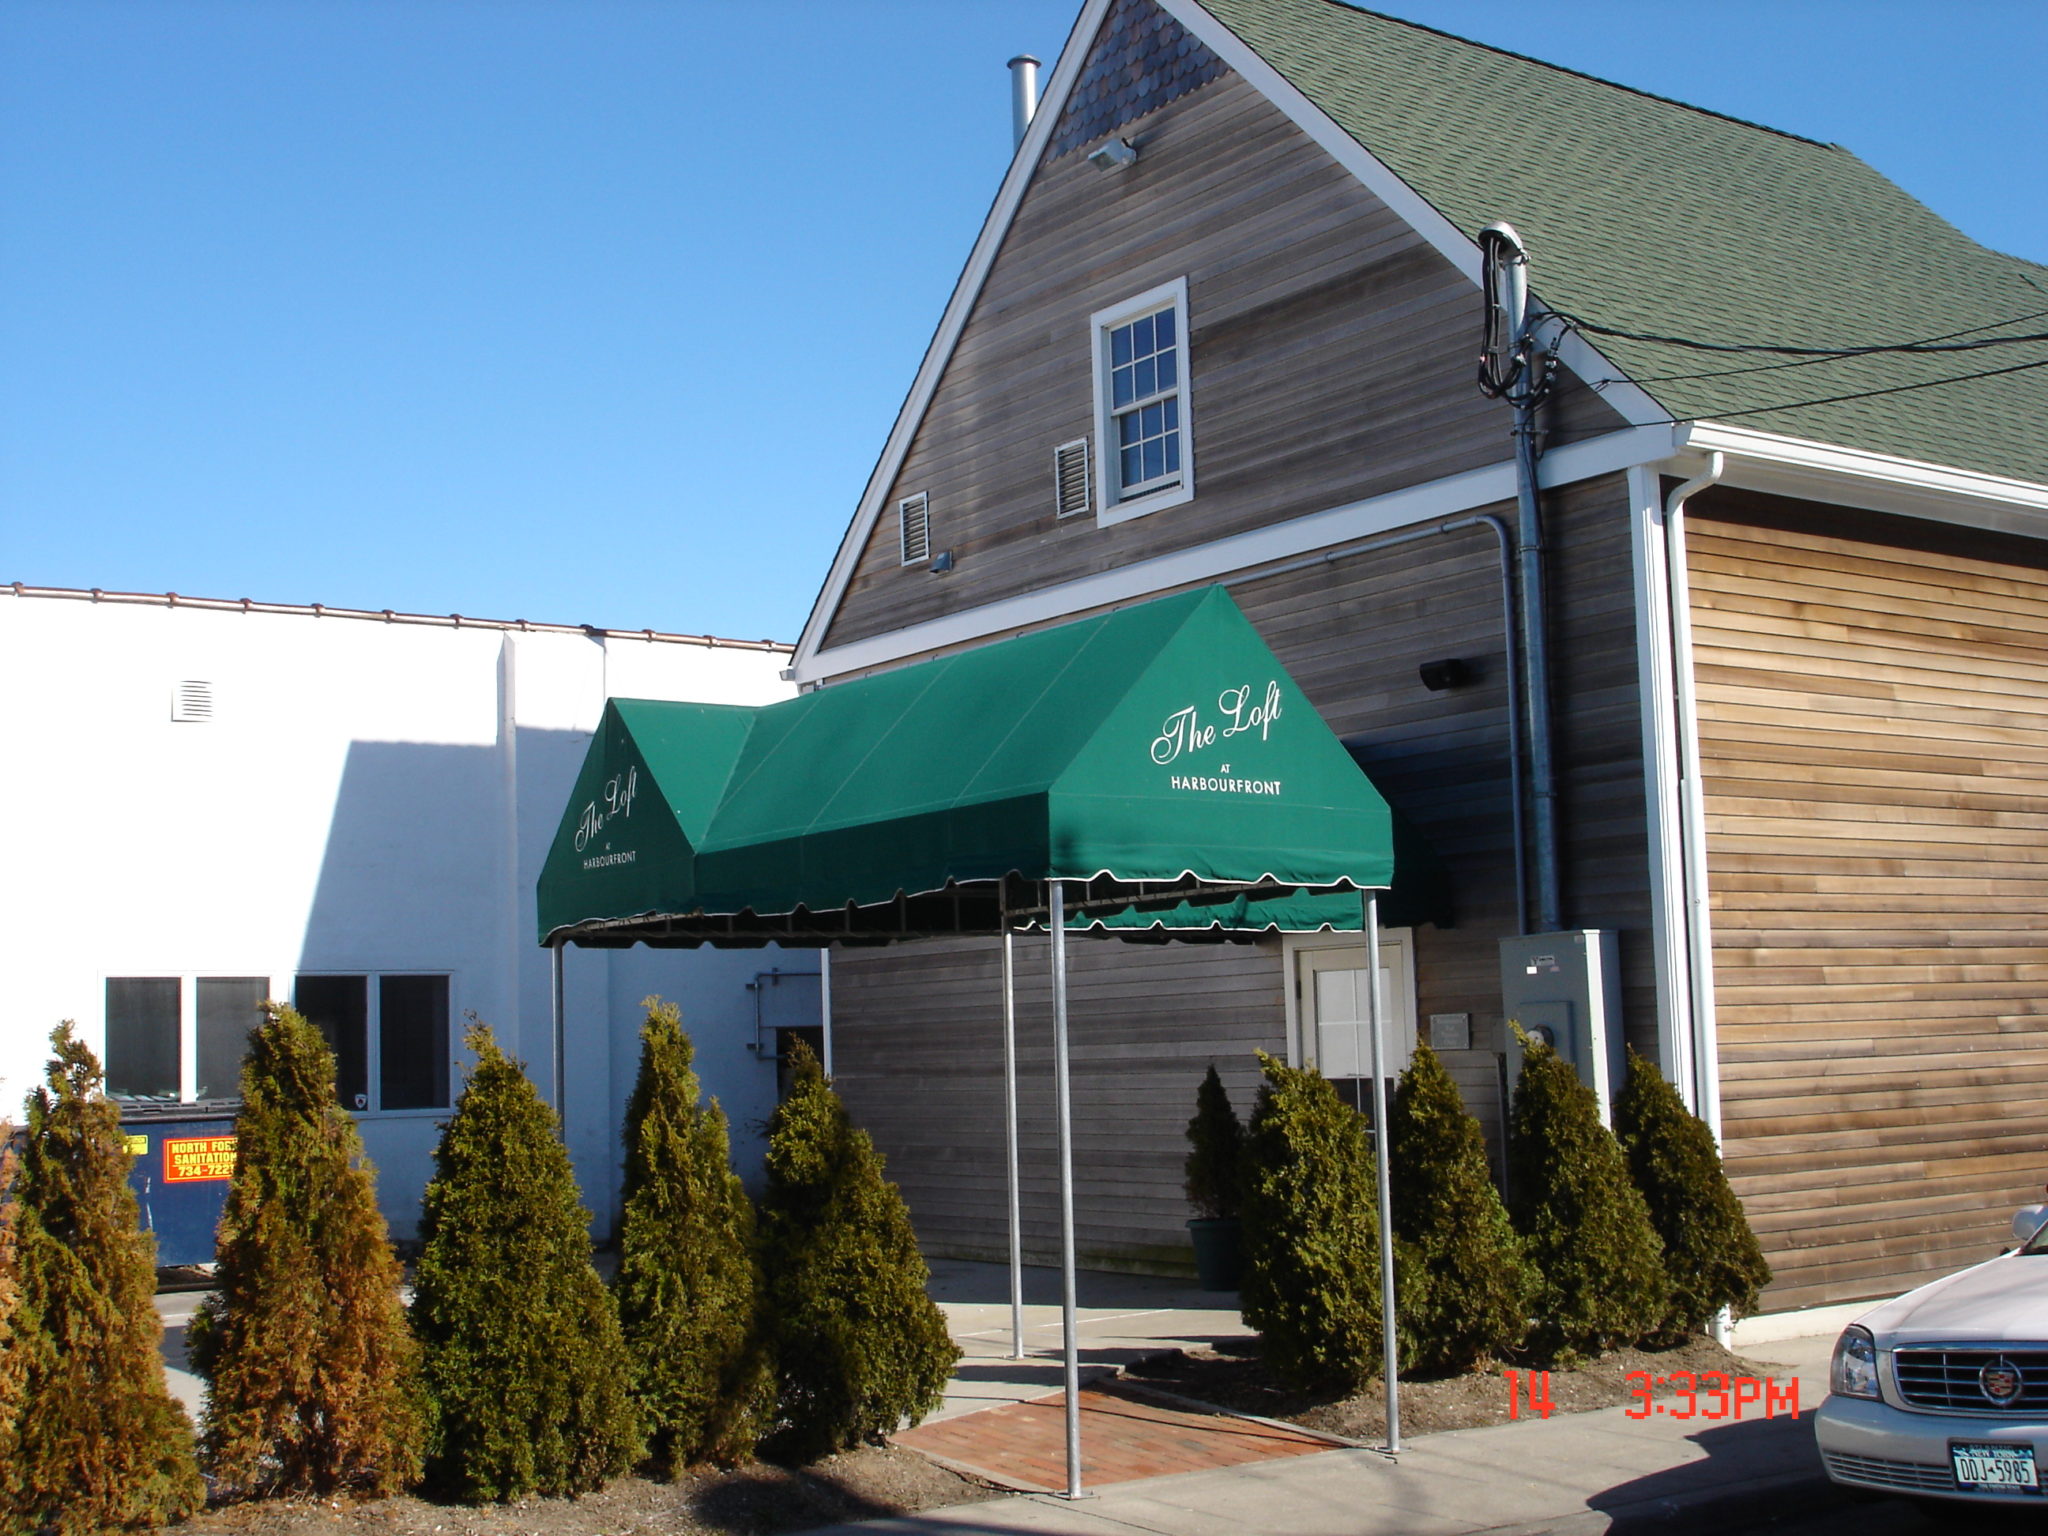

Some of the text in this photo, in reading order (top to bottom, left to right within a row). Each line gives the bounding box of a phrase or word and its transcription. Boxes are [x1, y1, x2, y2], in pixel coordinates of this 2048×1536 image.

[1150, 680, 1282, 765] The Loft
[1220, 763, 1231, 774] AT
[1171, 776, 1281, 795] HARBOURFRONT
[575, 765, 637, 852] The Loft
[583, 851, 637, 869] HARBOURFRONT
[171, 1141, 207, 1154] NORTH
